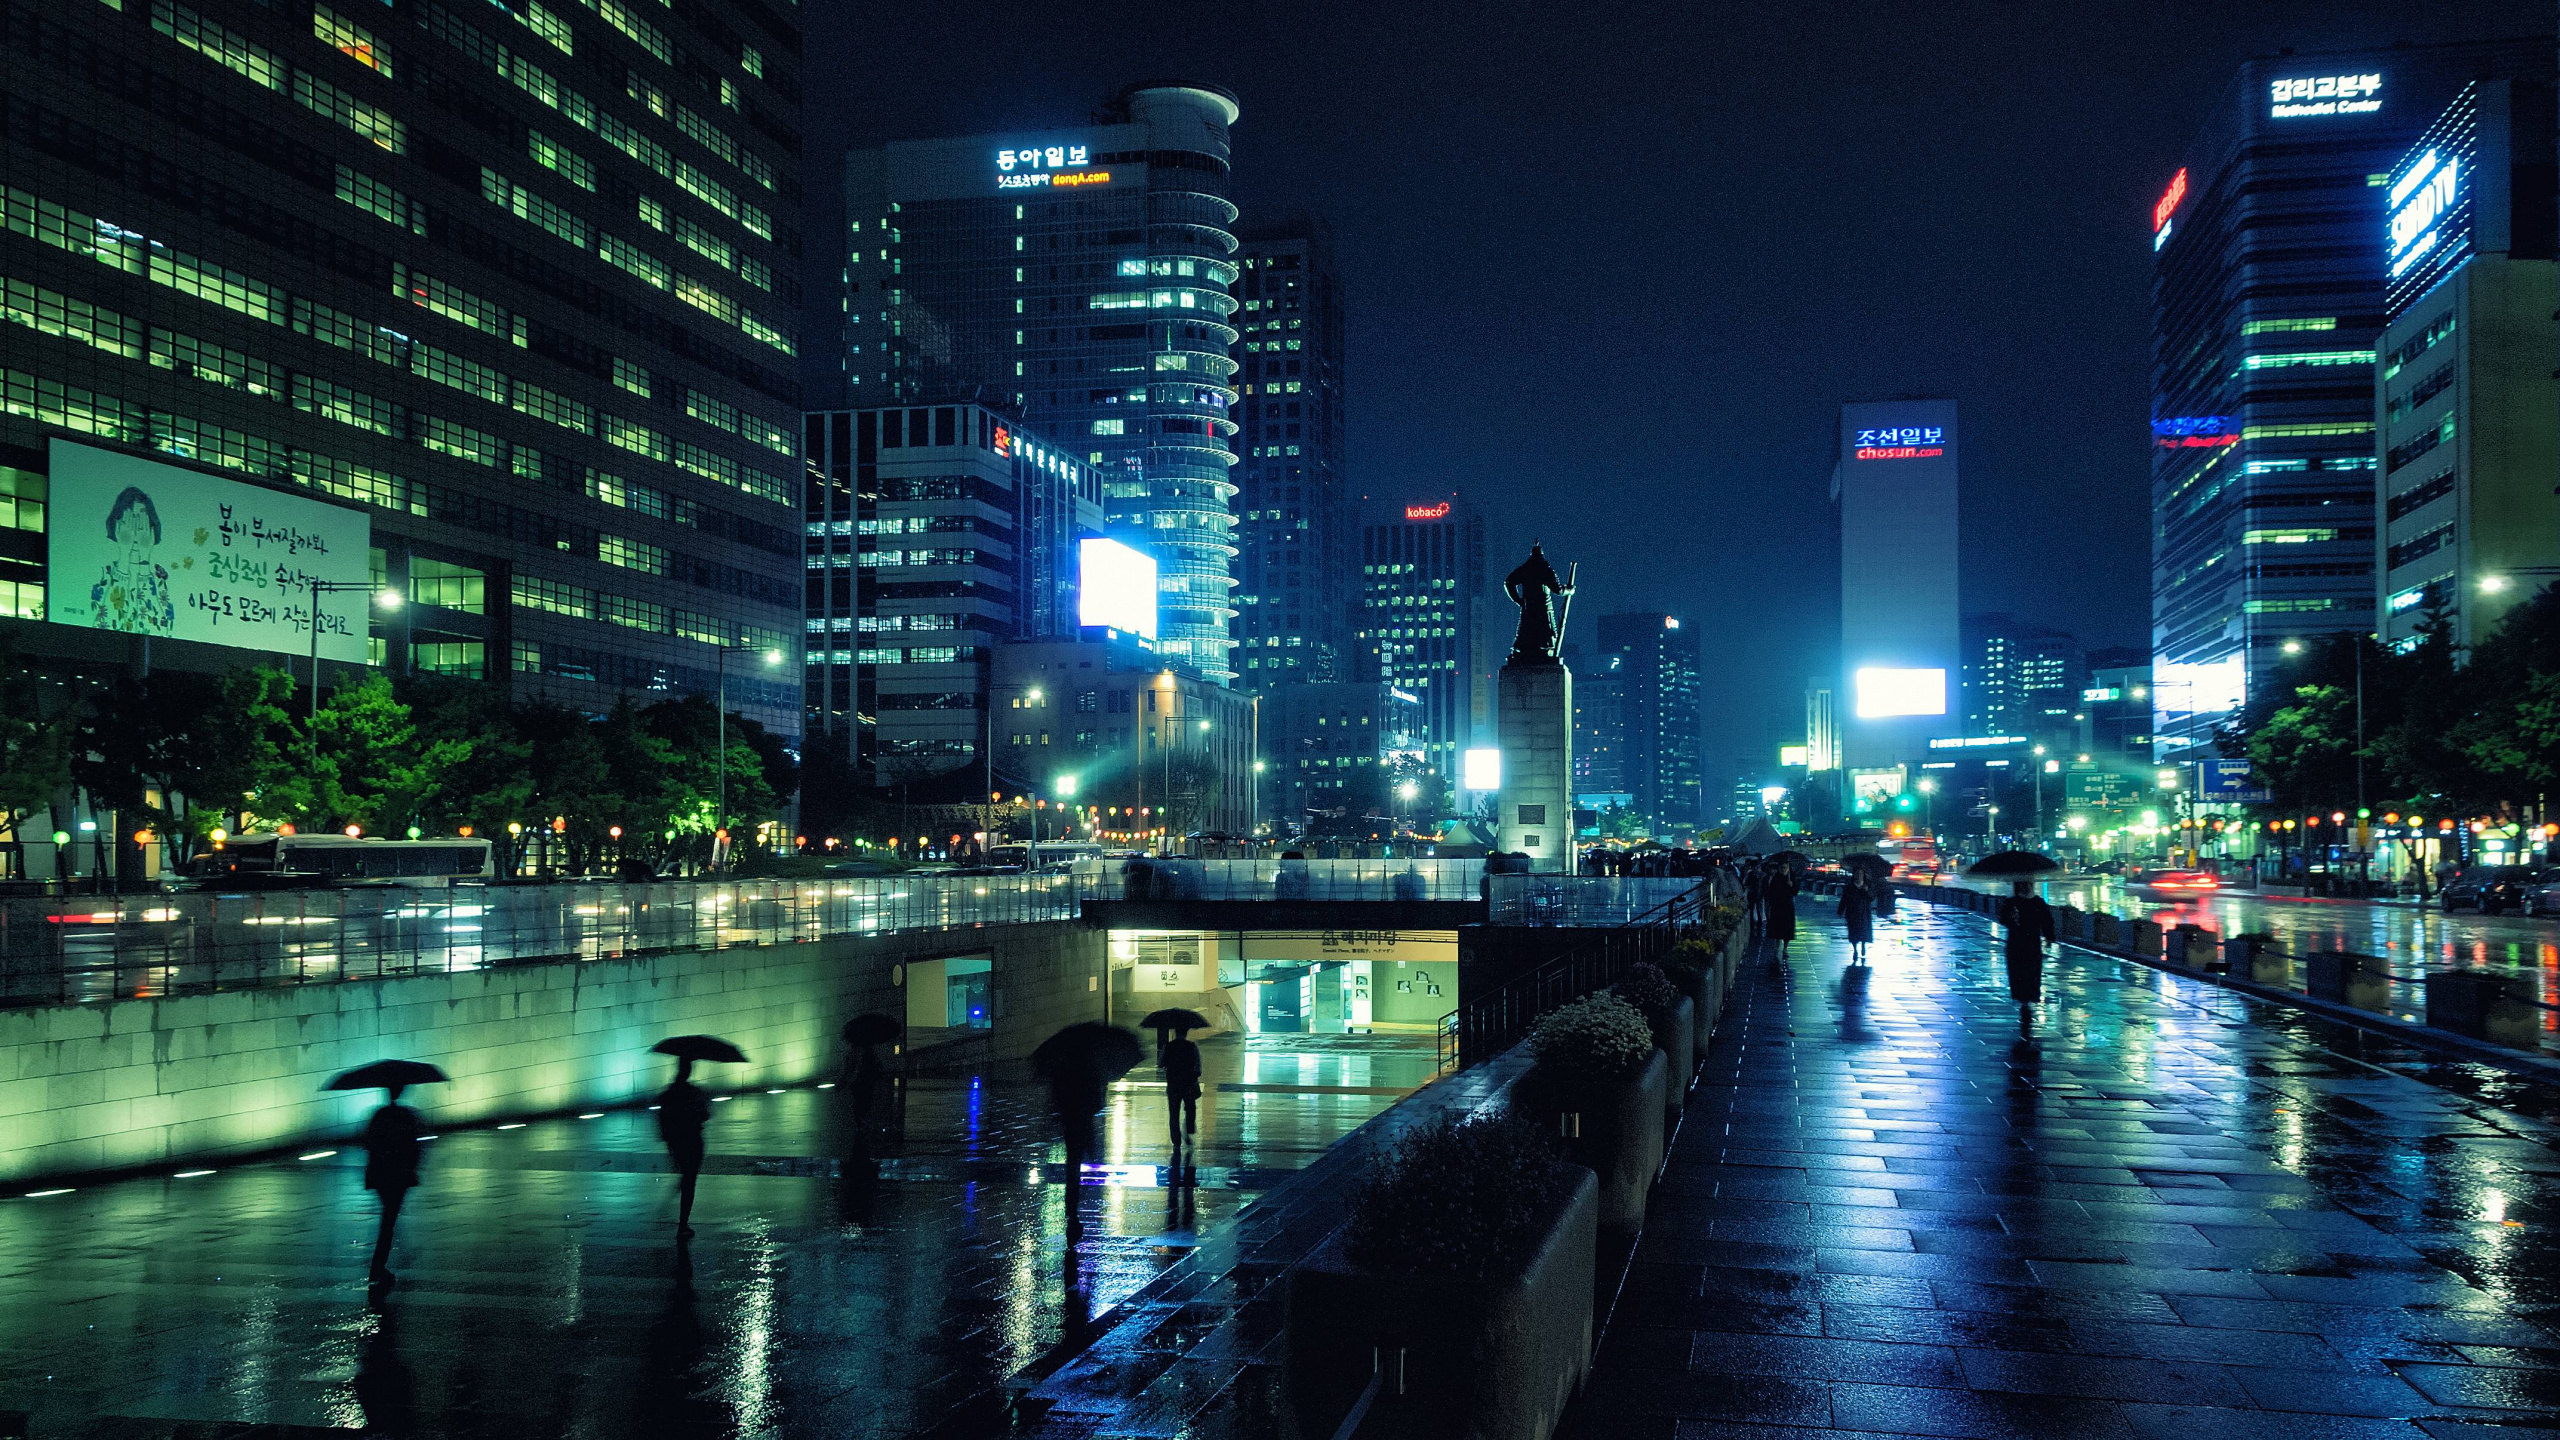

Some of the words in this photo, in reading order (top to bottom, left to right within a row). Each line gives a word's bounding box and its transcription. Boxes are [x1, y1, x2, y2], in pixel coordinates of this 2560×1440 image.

[2271, 73, 2383, 102] 감리교본부
[996, 145, 1088, 171] 동아일보
[1052, 171, 1110, 187] dongA.com
[1854, 427, 1946, 447] 조선일보
[1857, 446, 1943, 459] chosun.com
[1407, 506, 1442, 518] kobaco
[219, 502, 247, 547] 봄이
[251, 516, 329, 555] 부서질까봐
[208, 551, 268, 588] 조심조심
[188, 589, 233, 625] 아무도
[239, 596, 276, 624] 모르게
[282, 604, 310, 633] 작은
[316, 608, 354, 636] 소리로
